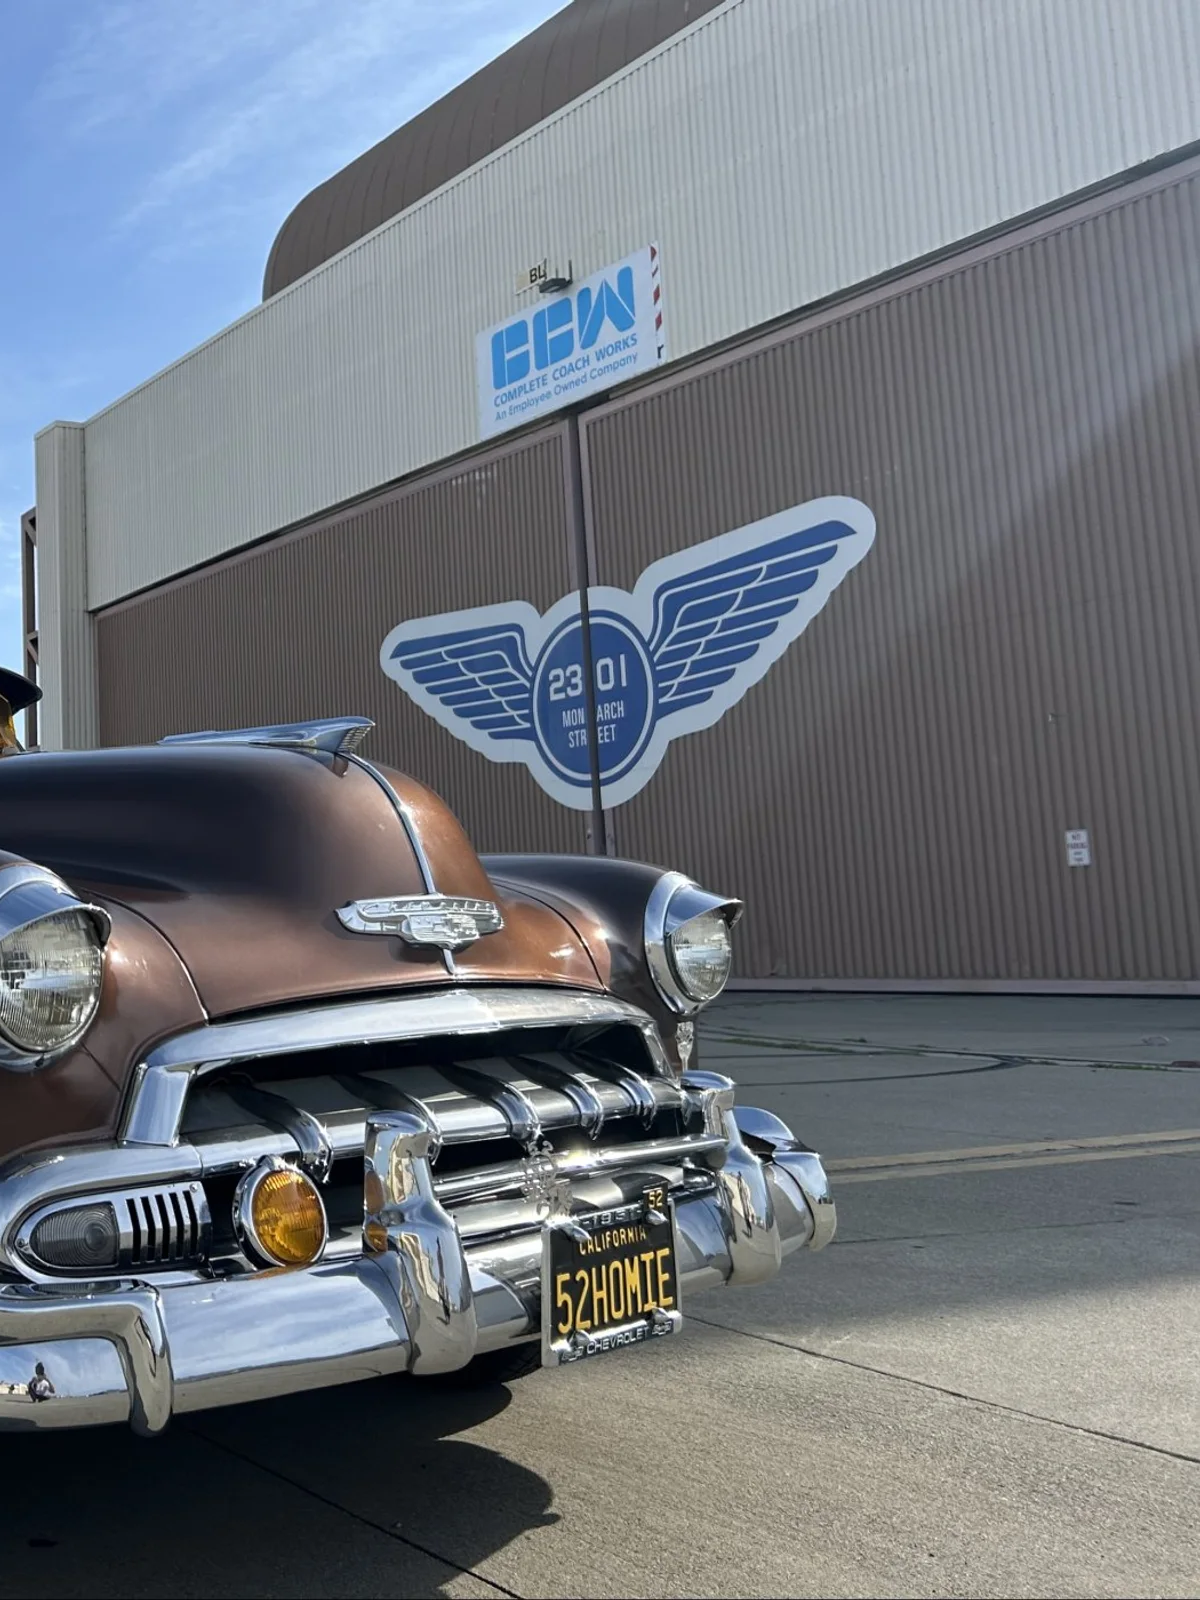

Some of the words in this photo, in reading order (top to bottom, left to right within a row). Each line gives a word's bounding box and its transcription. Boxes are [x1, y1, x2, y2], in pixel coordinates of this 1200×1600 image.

[494, 373, 549, 407] COMPLETE
[552, 354, 590, 383] COACH
[595, 332, 638, 362] WORKS
[494, 410, 508, 421] An
[508, 390, 552, 416] Employee
[554, 371, 587, 396] Owned
[589, 352, 638, 380] Company
[648, 1188, 664, 1209] 52
[579, 1225, 647, 1256] CALIFORNIA
[556, 1247, 674, 1335] 52HOMIE
[586, 1326, 649, 1355] CHEVROLET
